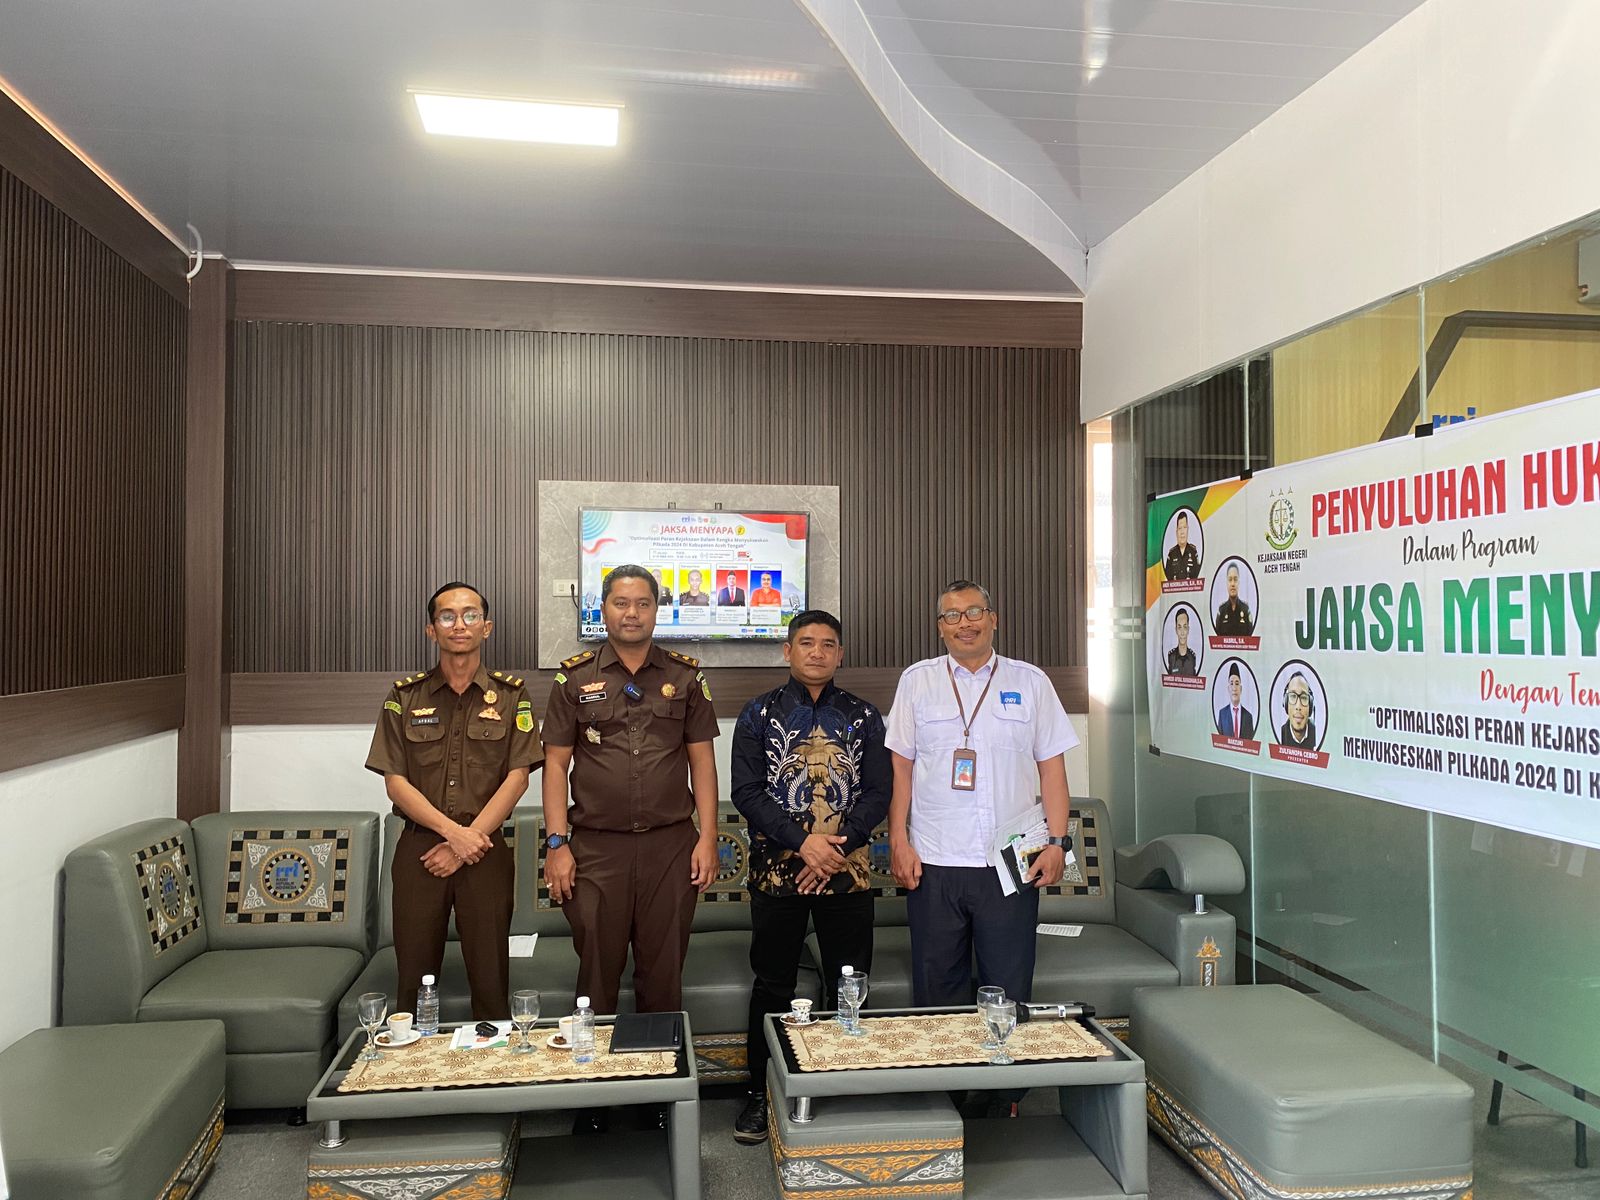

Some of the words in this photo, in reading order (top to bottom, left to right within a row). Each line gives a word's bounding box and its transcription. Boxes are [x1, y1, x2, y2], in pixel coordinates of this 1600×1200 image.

[1311, 458, 1507, 538] PENYULUHAN
[1523, 440, 1600, 511] HUK
[660, 525, 688, 534] JAKSA
[689, 526, 734, 535] MENYAPA
[1403, 535, 1457, 565] Dalam
[1462, 528, 1539, 567] Program
[1257, 551, 1287, 563] KEJAKSAAN
[1288, 549, 1308, 560] NEGERI
[1264, 564, 1279, 574] ACEH
[1279, 562, 1301, 573] TENGAH
[1295, 582, 1424, 653] JAKSA
[1443, 571, 1600, 657] MENY
[1480, 668, 1563, 714] Dengan
[1475, 717, 1525, 747] PERAN
[1531, 722, 1600, 755] KEJAKS
[1343, 736, 1443, 773] MENYUKSESKAN
[1448, 751, 1510, 784] PILKADA
[1515, 762, 1557, 792] 2024
[1564, 768, 1581, 796] DI
